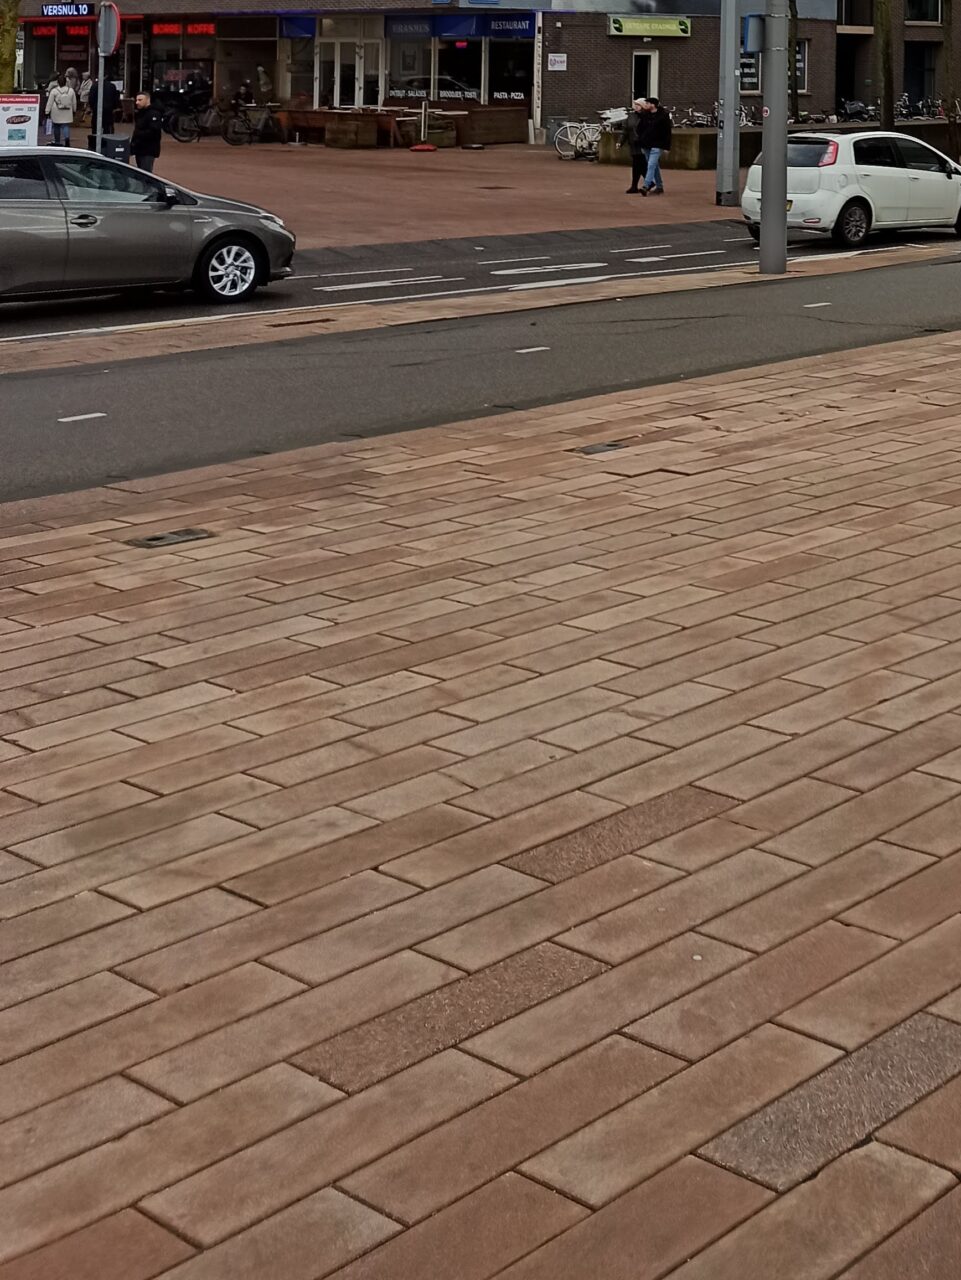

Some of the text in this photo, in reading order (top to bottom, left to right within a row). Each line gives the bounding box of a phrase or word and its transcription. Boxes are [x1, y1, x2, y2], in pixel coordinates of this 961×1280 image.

[42, 4, 88, 16] VERSNUL 10
[152, 23, 183, 35] BORRE
[491, 20, 530, 30] RESTAURANT
[493, 91, 525, 100] PASTA PIZZA
